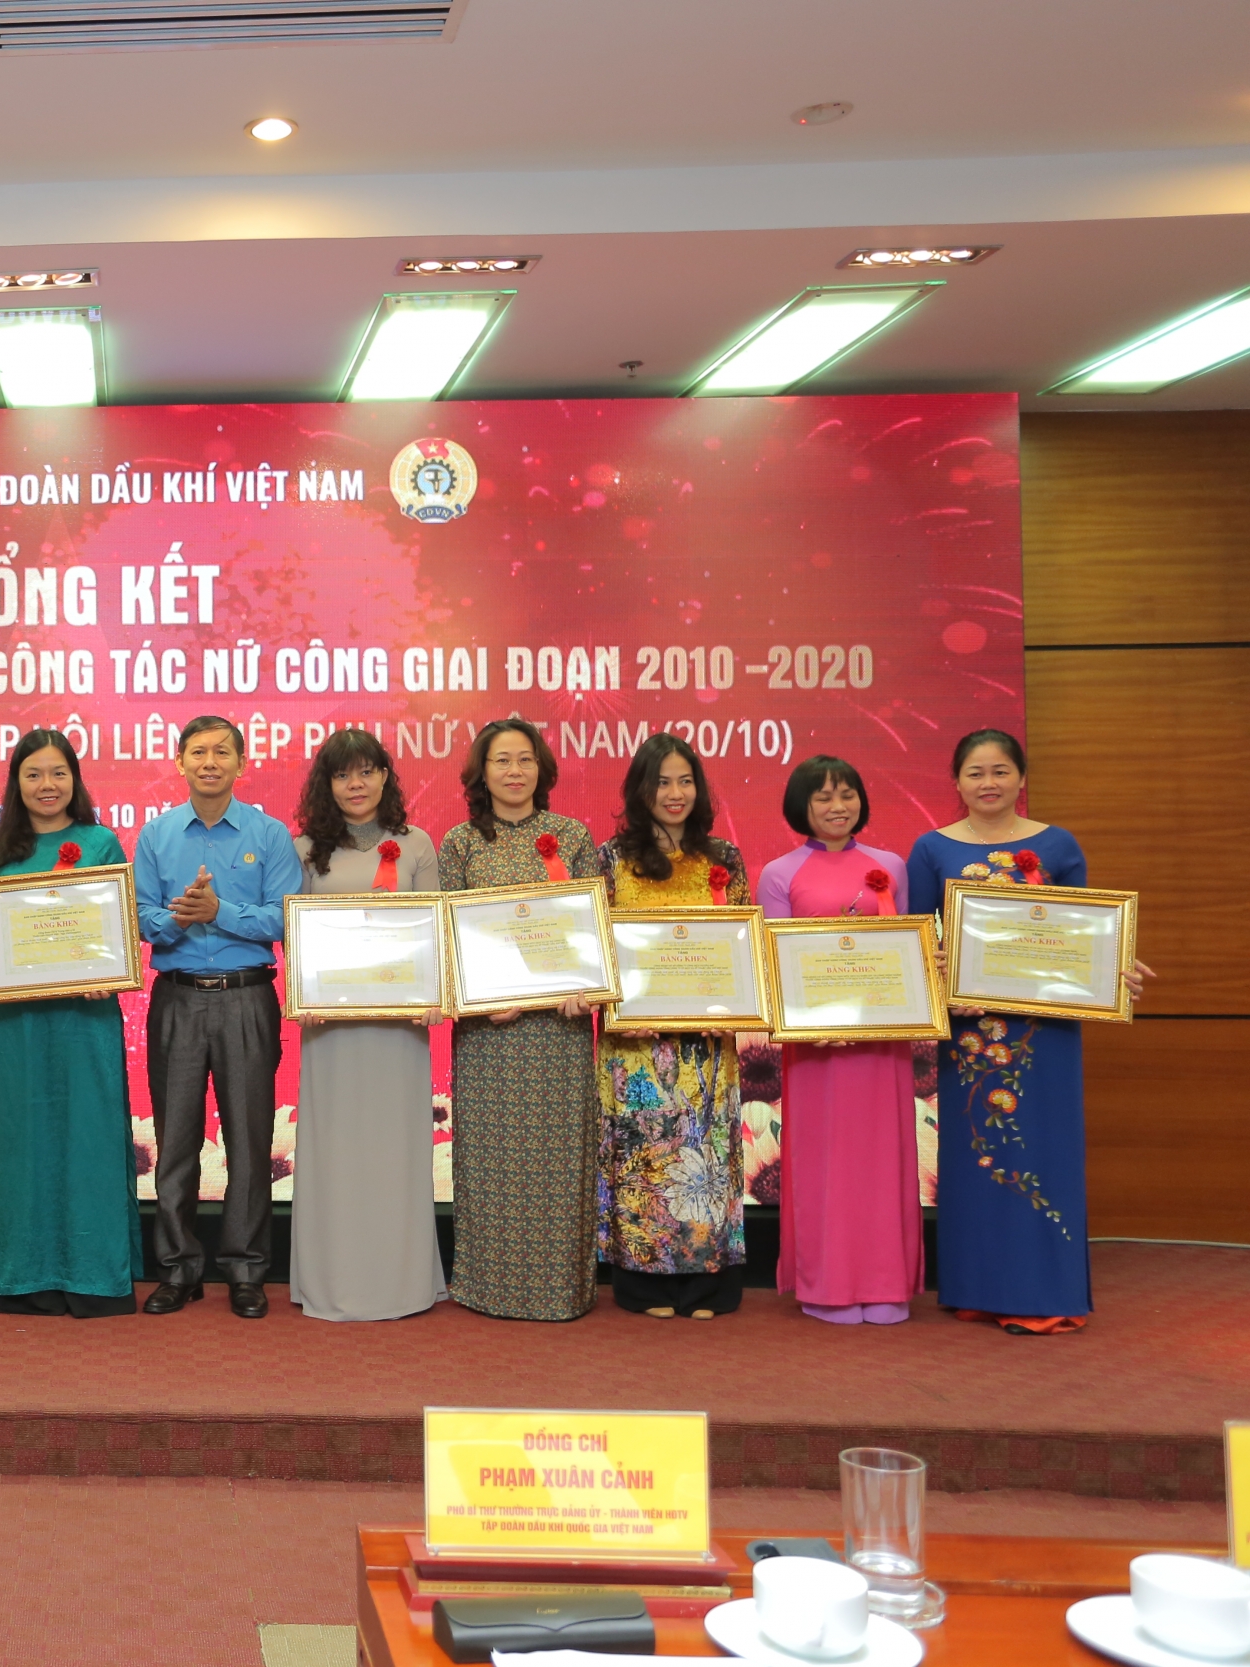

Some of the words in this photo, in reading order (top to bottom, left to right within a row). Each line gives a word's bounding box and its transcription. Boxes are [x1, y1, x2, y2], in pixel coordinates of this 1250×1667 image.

[92, 462, 151, 504] DẦU
[163, 462, 217, 503] KHÍ
[226, 462, 290, 510] VIỆT
[299, 469, 364, 502] NAM
[121, 541, 220, 625] KẾT
[110, 640, 187, 695] TÁC
[203, 638, 263, 693] NỮ
[275, 638, 388, 694] CÔNG
[403, 646, 488, 693] GIAI
[504, 645, 621, 701] ĐOẠN
[636, 645, 735, 691] 2010
[396, 712, 460, 759] NỮ
[560, 720, 649, 759] NAM
[109, 803, 135, 829] 10
[56, 919, 79, 928] KHEN
[578, 1430, 608, 1452] CHÍ
[479, 1466, 536, 1491] PHẠM
[542, 1464, 595, 1489] XUÂN
[601, 1461, 654, 1490] CẢNH
[592, 1523, 608, 1533] GIA
[610, 1522, 630, 1535] VIỆT
[632, 1524, 654, 1534] NAM
